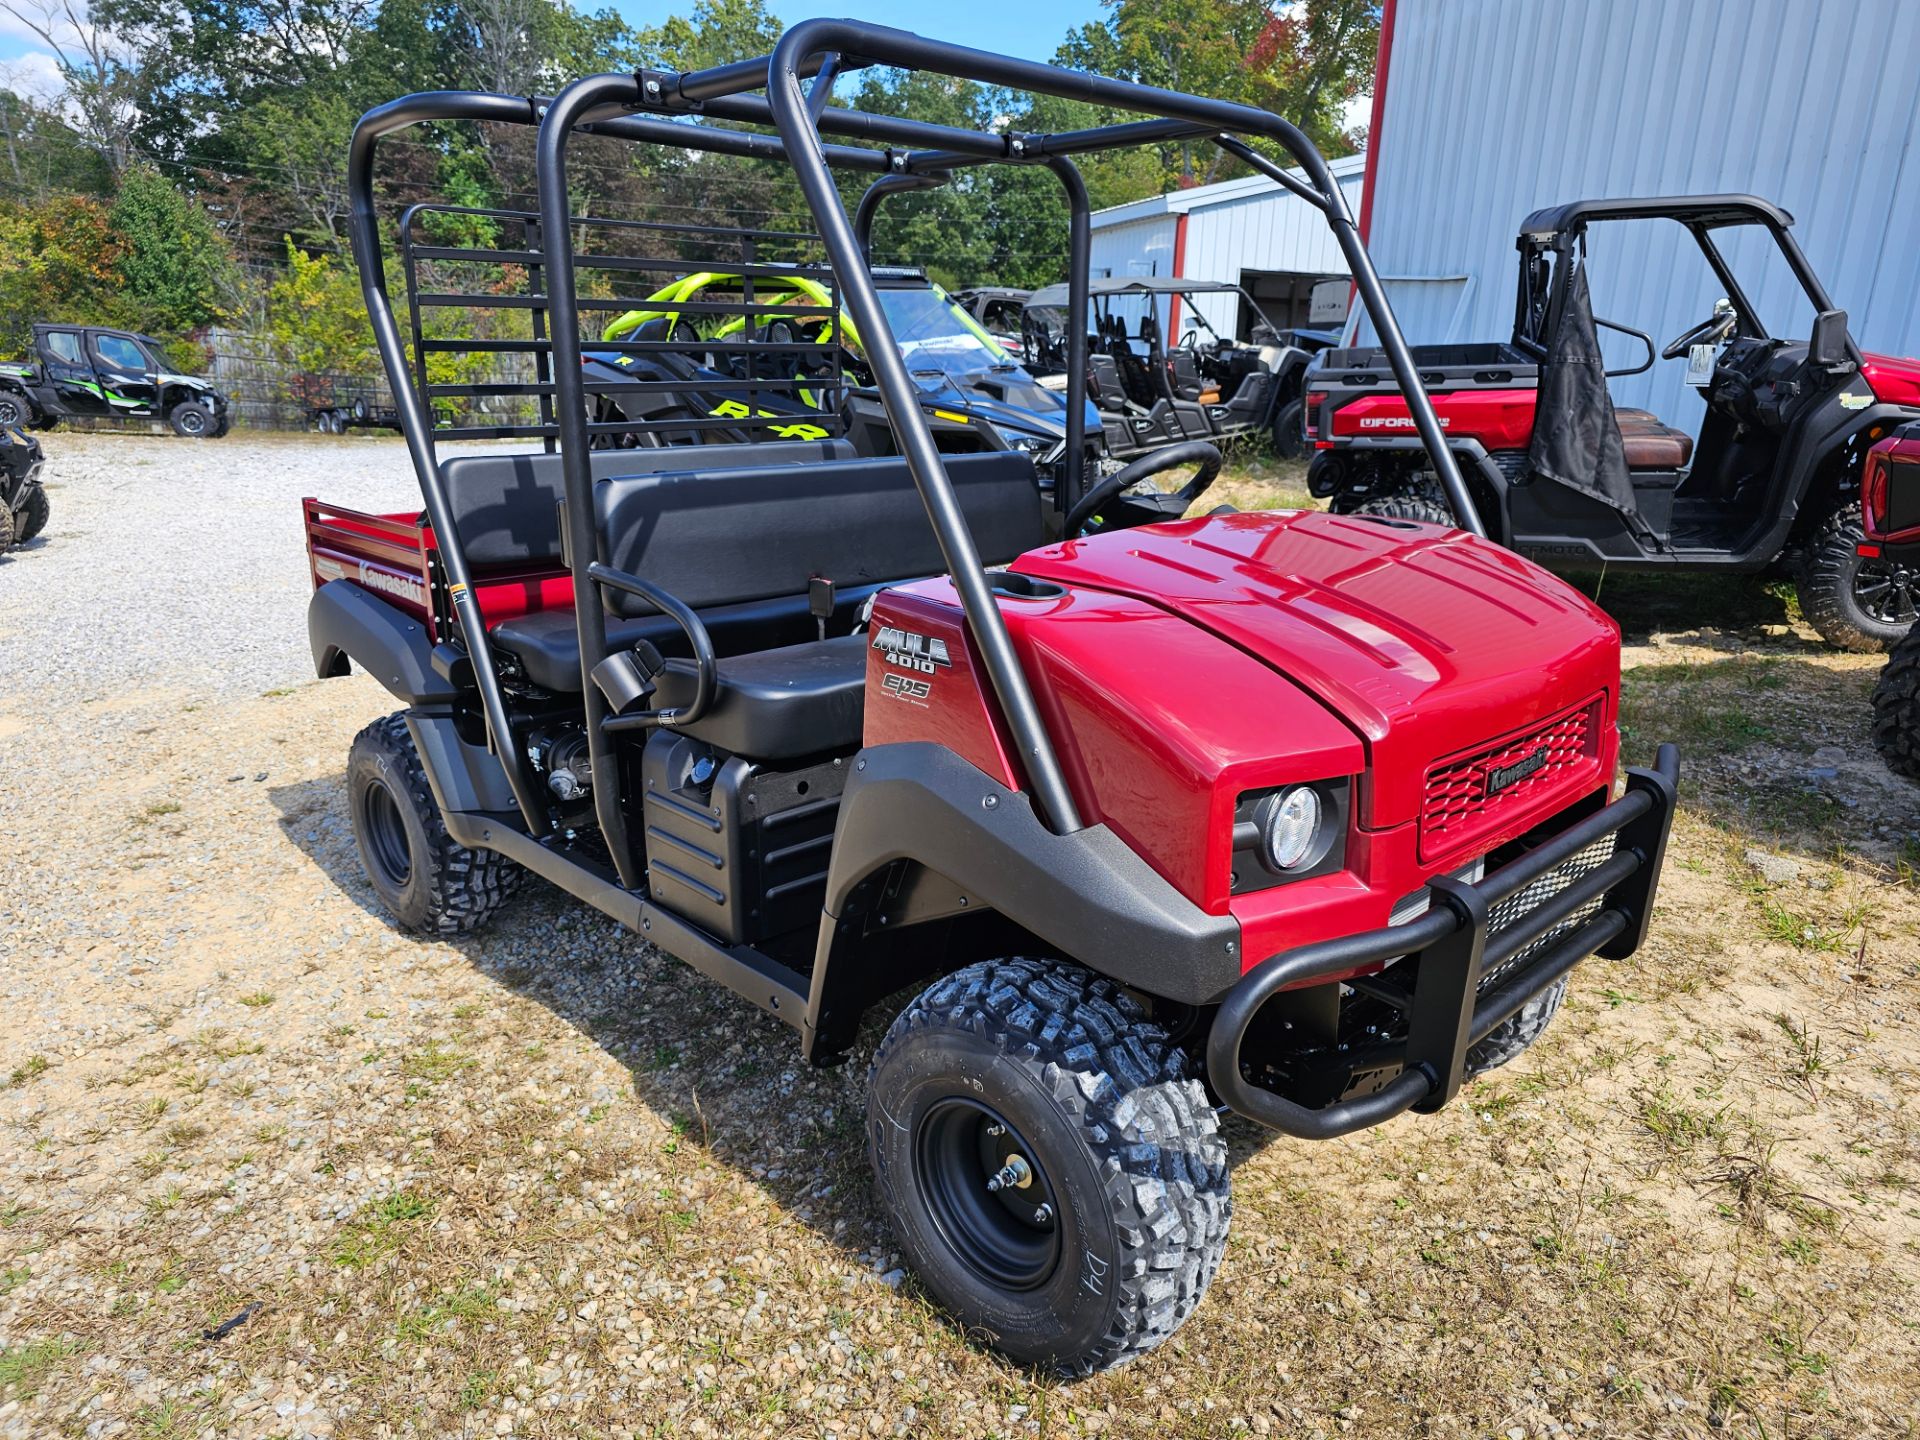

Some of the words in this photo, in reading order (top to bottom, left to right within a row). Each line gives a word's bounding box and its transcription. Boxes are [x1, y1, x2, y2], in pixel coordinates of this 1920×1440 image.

[359, 560, 422, 602] Kawasaki
[872, 627, 952, 667] MULE
[885, 653, 936, 674] 4010
[882, 673, 931, 698] EPS
[1489, 745, 1548, 793] Kawasaki
